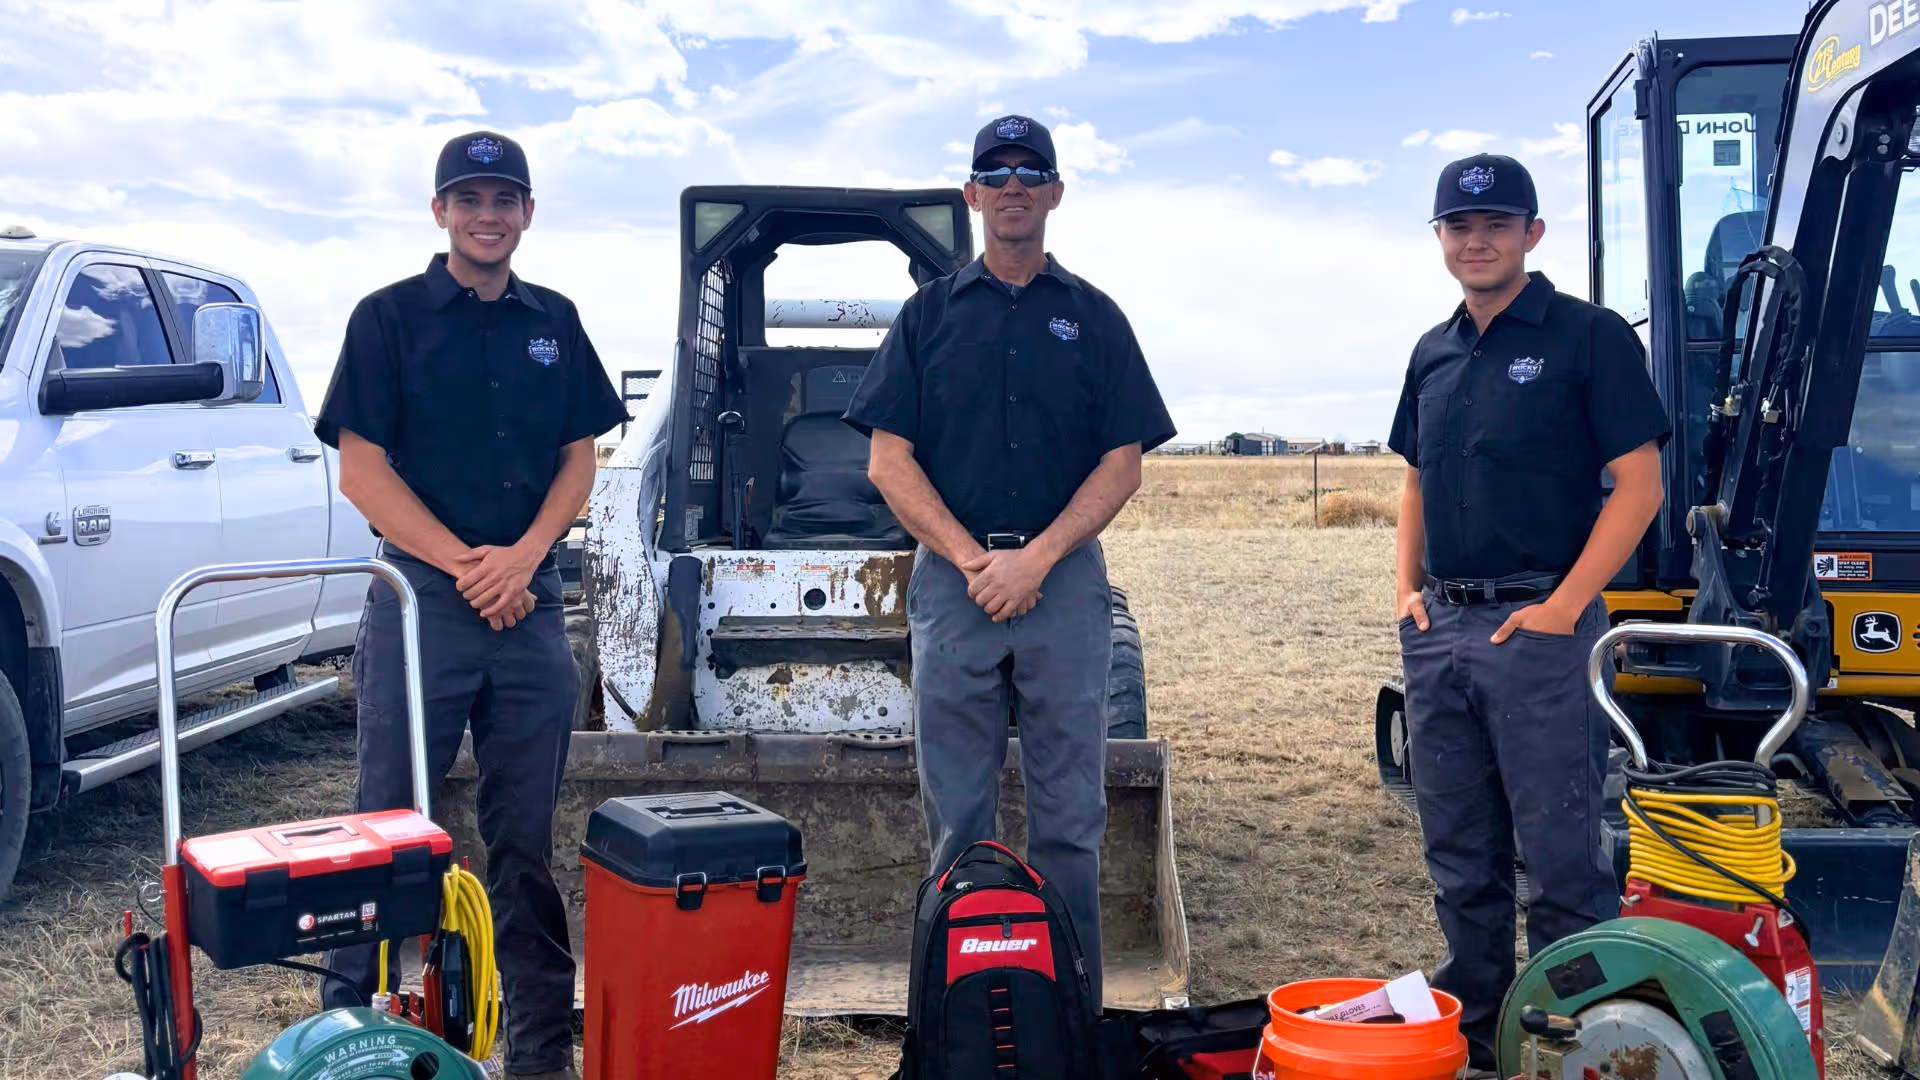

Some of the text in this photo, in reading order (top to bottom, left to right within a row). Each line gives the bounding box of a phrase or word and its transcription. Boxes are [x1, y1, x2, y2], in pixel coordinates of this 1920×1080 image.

[1825, 44, 1861, 79] Century
[1462, 174, 1490, 182] ROCKY
[78, 518, 110, 534] RAM
[317, 911, 356, 924] SPARTAN
[960, 938, 1037, 954] Bauer
[670, 969, 770, 1018] Milwaukee
[1340, 1003, 1366, 1019] GLOVES
[324, 1035, 396, 1063] WARNING
